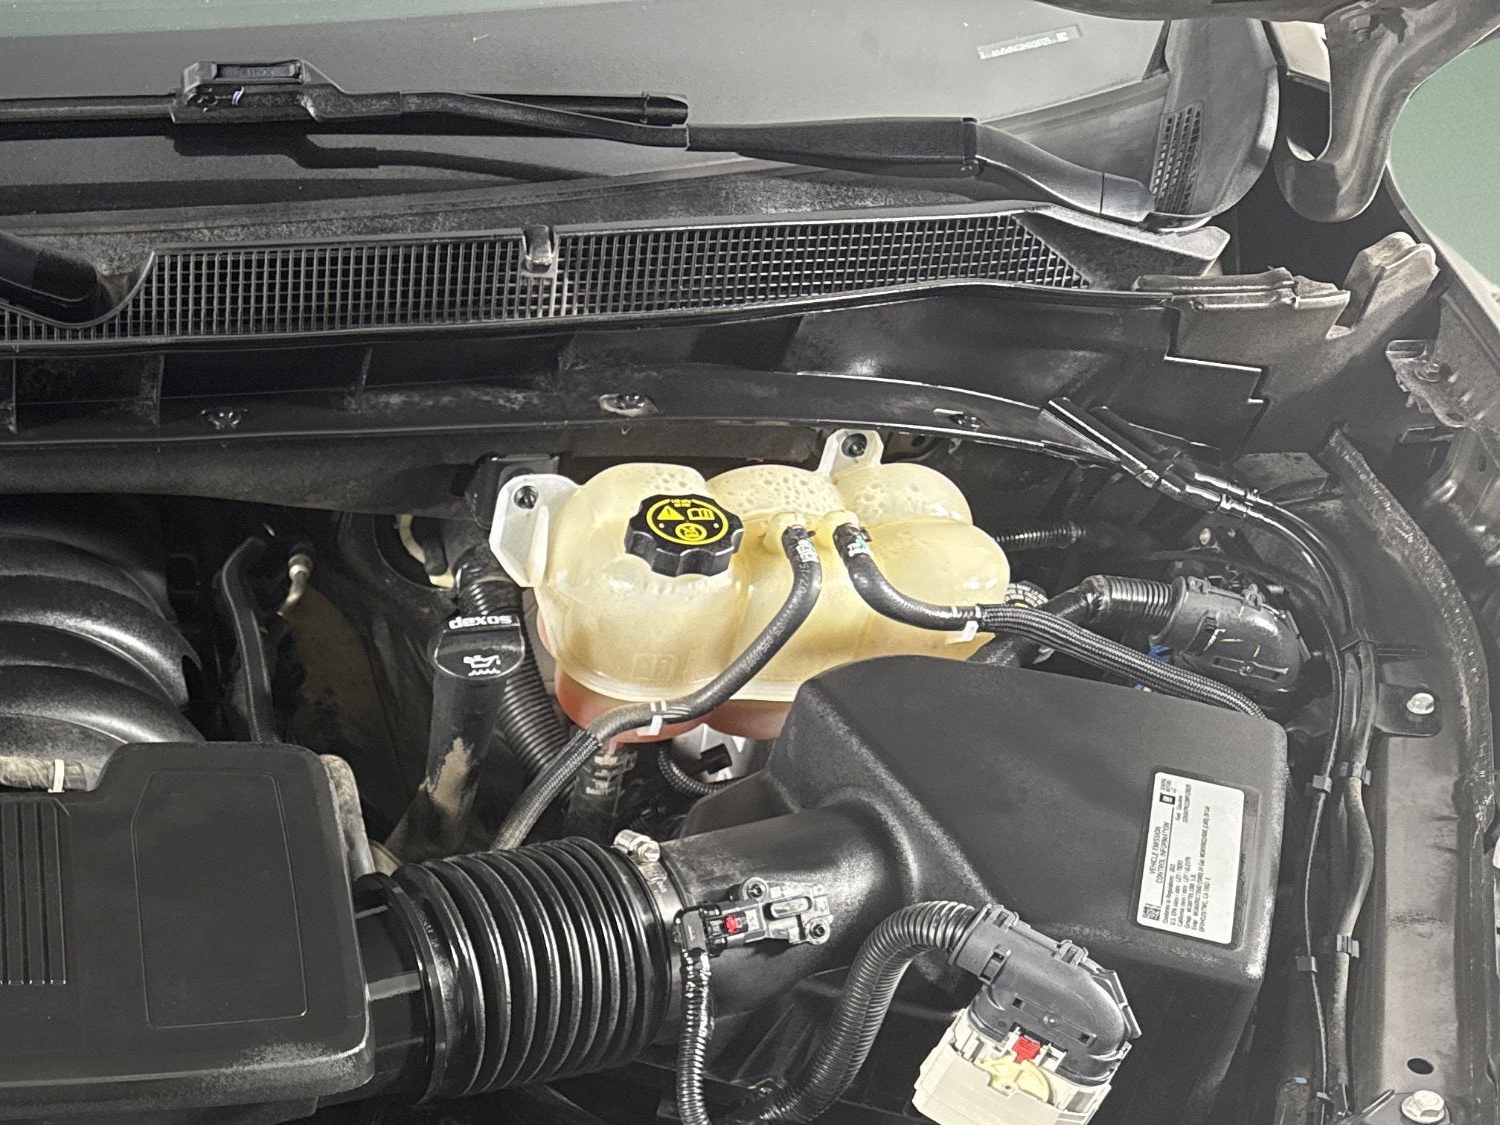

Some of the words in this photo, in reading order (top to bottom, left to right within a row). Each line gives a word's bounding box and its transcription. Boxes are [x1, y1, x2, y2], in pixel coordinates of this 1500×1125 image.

[448, 615, 512, 630] dexos
[1152, 825, 1162, 850] EMISSION
[1159, 822, 1170, 857] INFORMATION
[1149, 850, 1158, 875] VEHICLE
[1156, 858, 1165, 884] CONTROL
